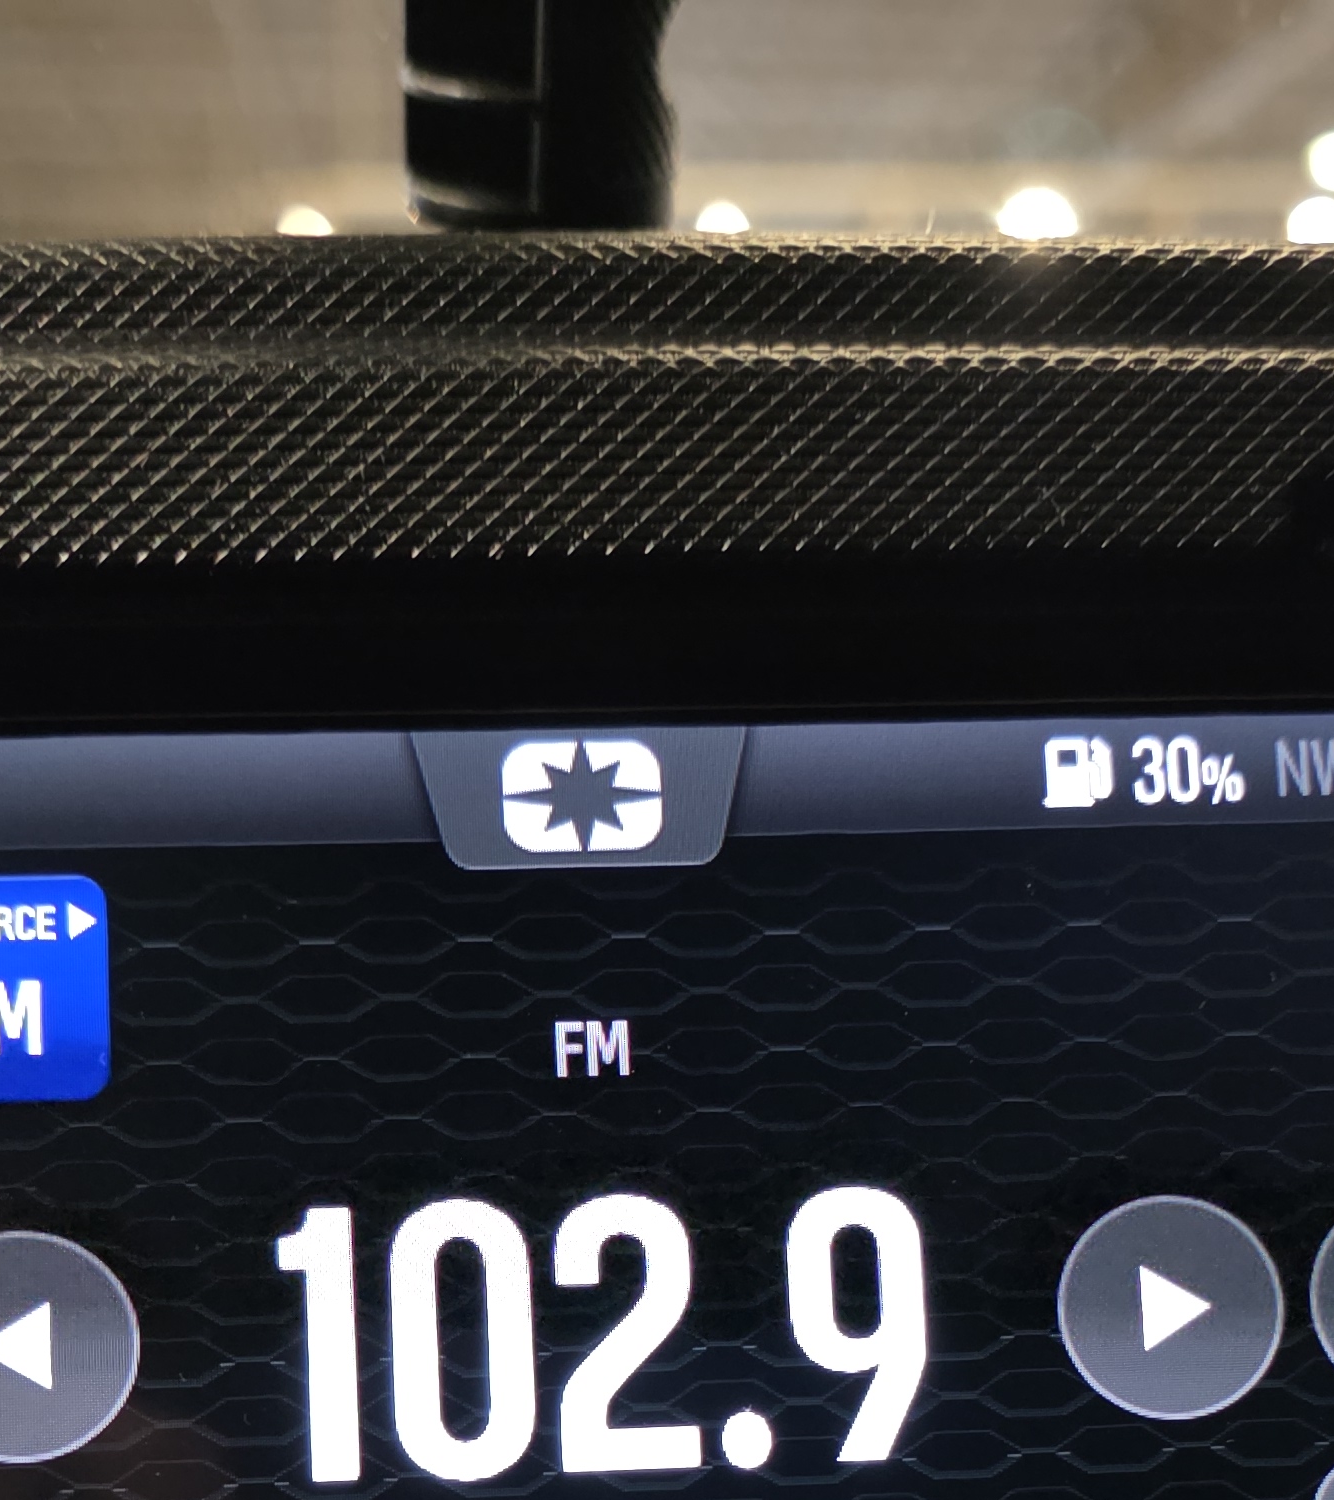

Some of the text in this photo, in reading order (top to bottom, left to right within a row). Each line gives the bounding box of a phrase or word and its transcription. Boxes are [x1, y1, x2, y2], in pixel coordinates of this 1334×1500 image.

[1130, 734, 1246, 806] 30%
[553, 1018, 631, 1079] FM
[276, 1185, 928, 1484] 102.9
